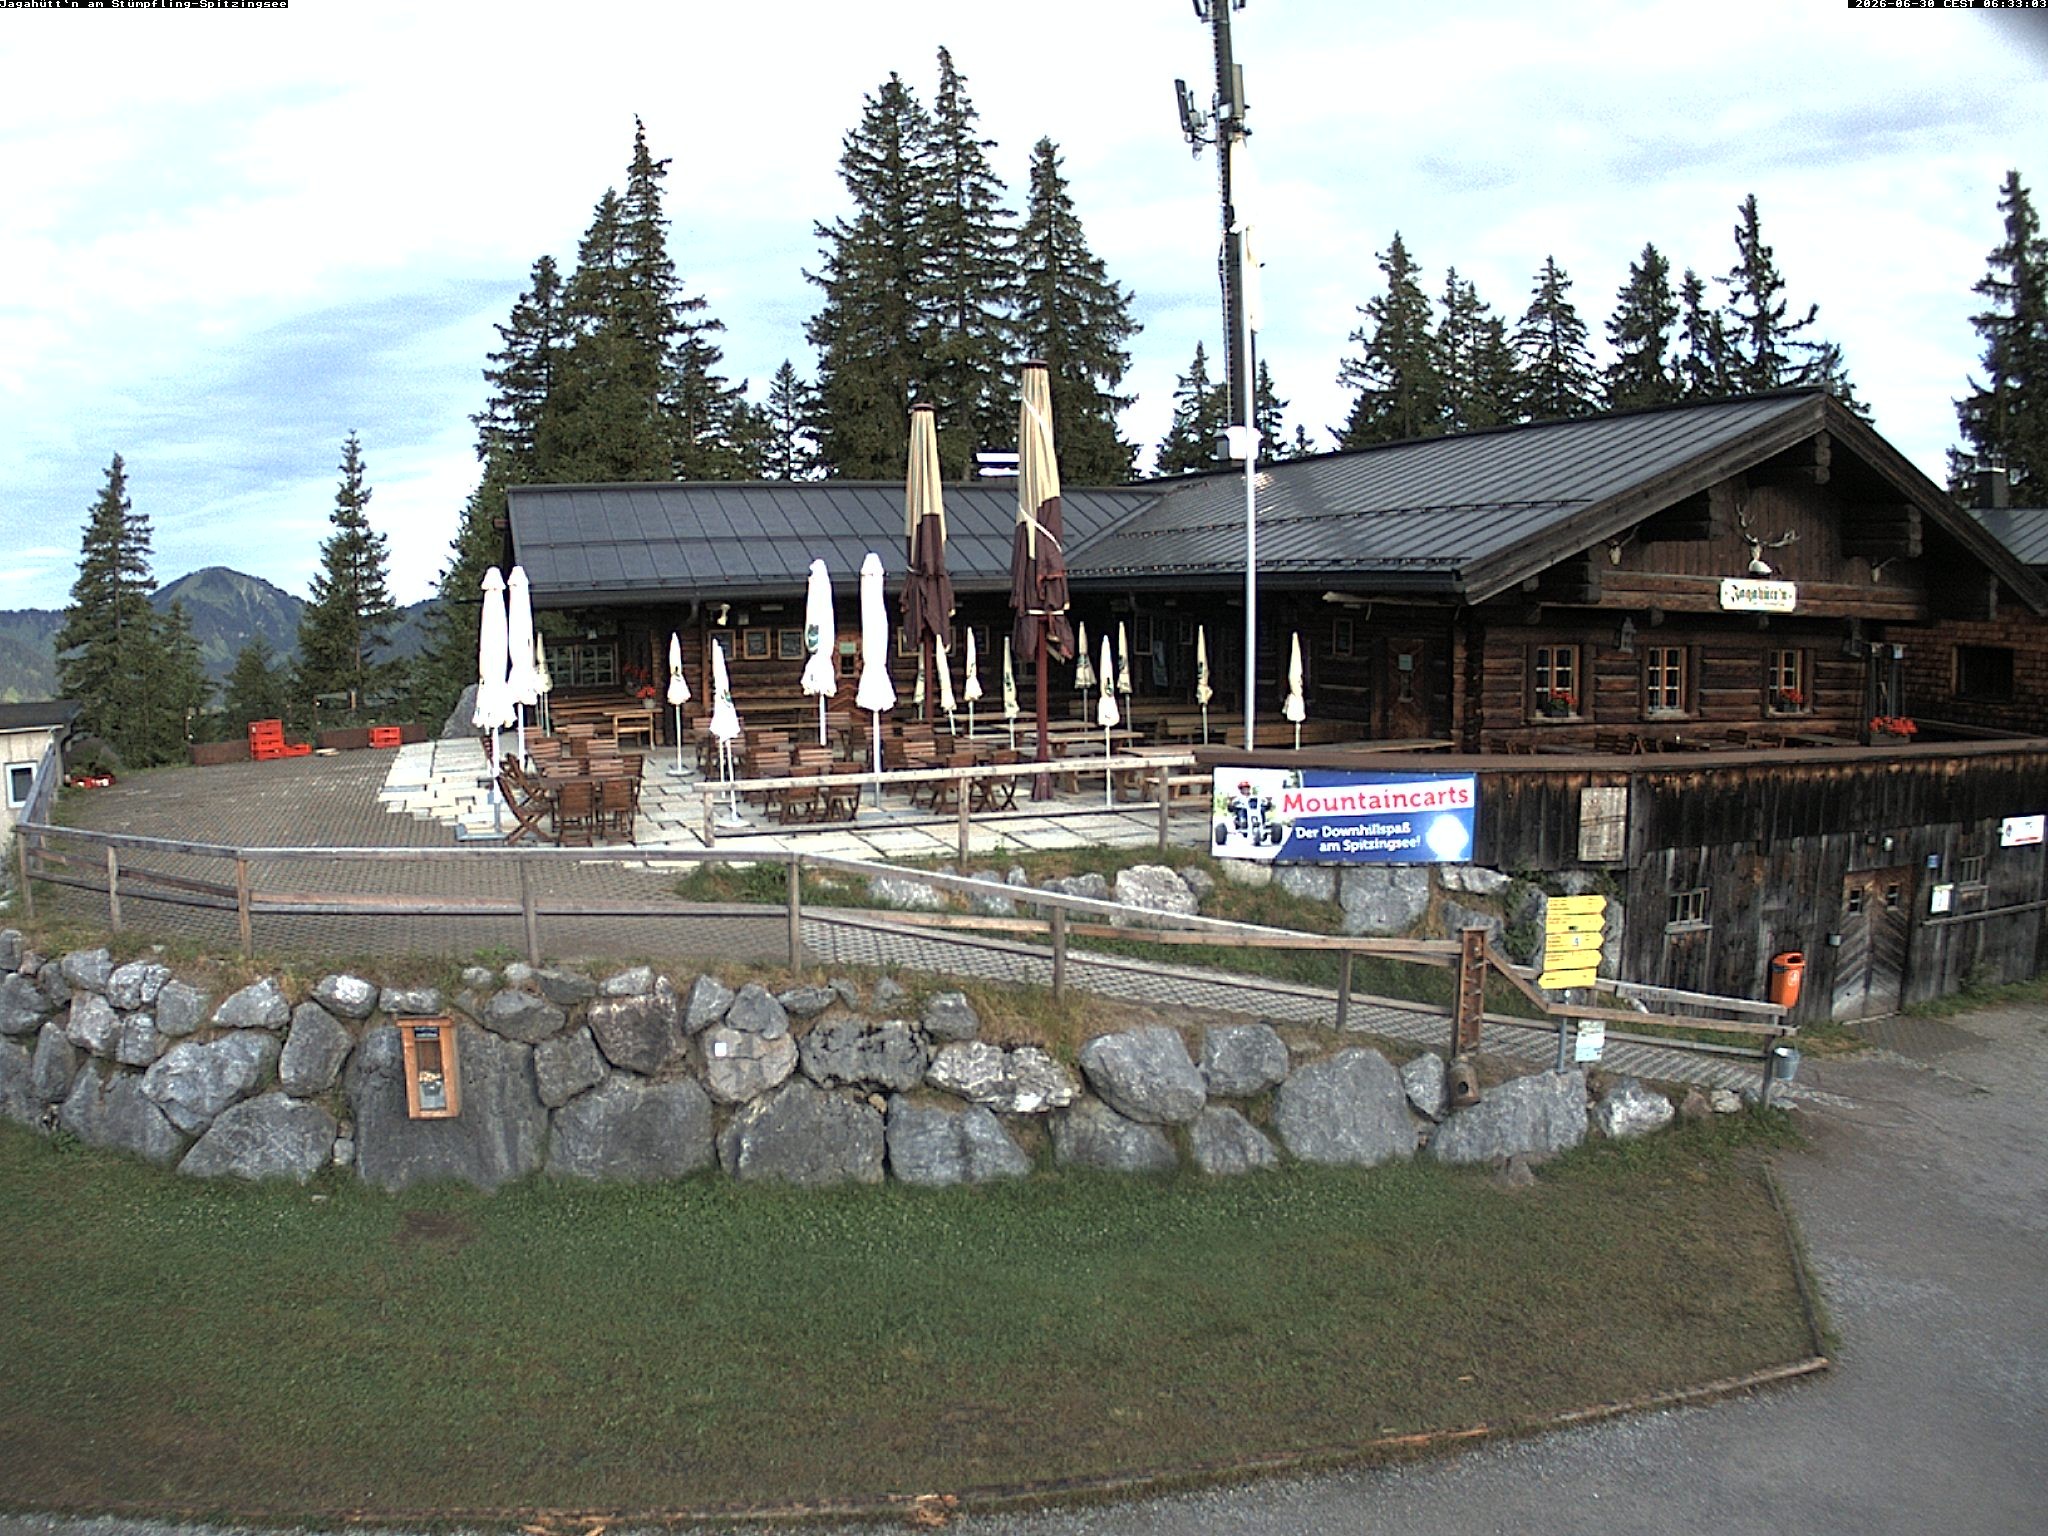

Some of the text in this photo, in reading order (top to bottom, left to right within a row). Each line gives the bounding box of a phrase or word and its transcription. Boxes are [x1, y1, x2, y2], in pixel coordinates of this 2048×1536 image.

[1283, 786, 1469, 813] Mountaincarts
[1295, 821, 1412, 839] Der Downhillspaß
[1319, 835, 1421, 853] am Spitzingsee!
